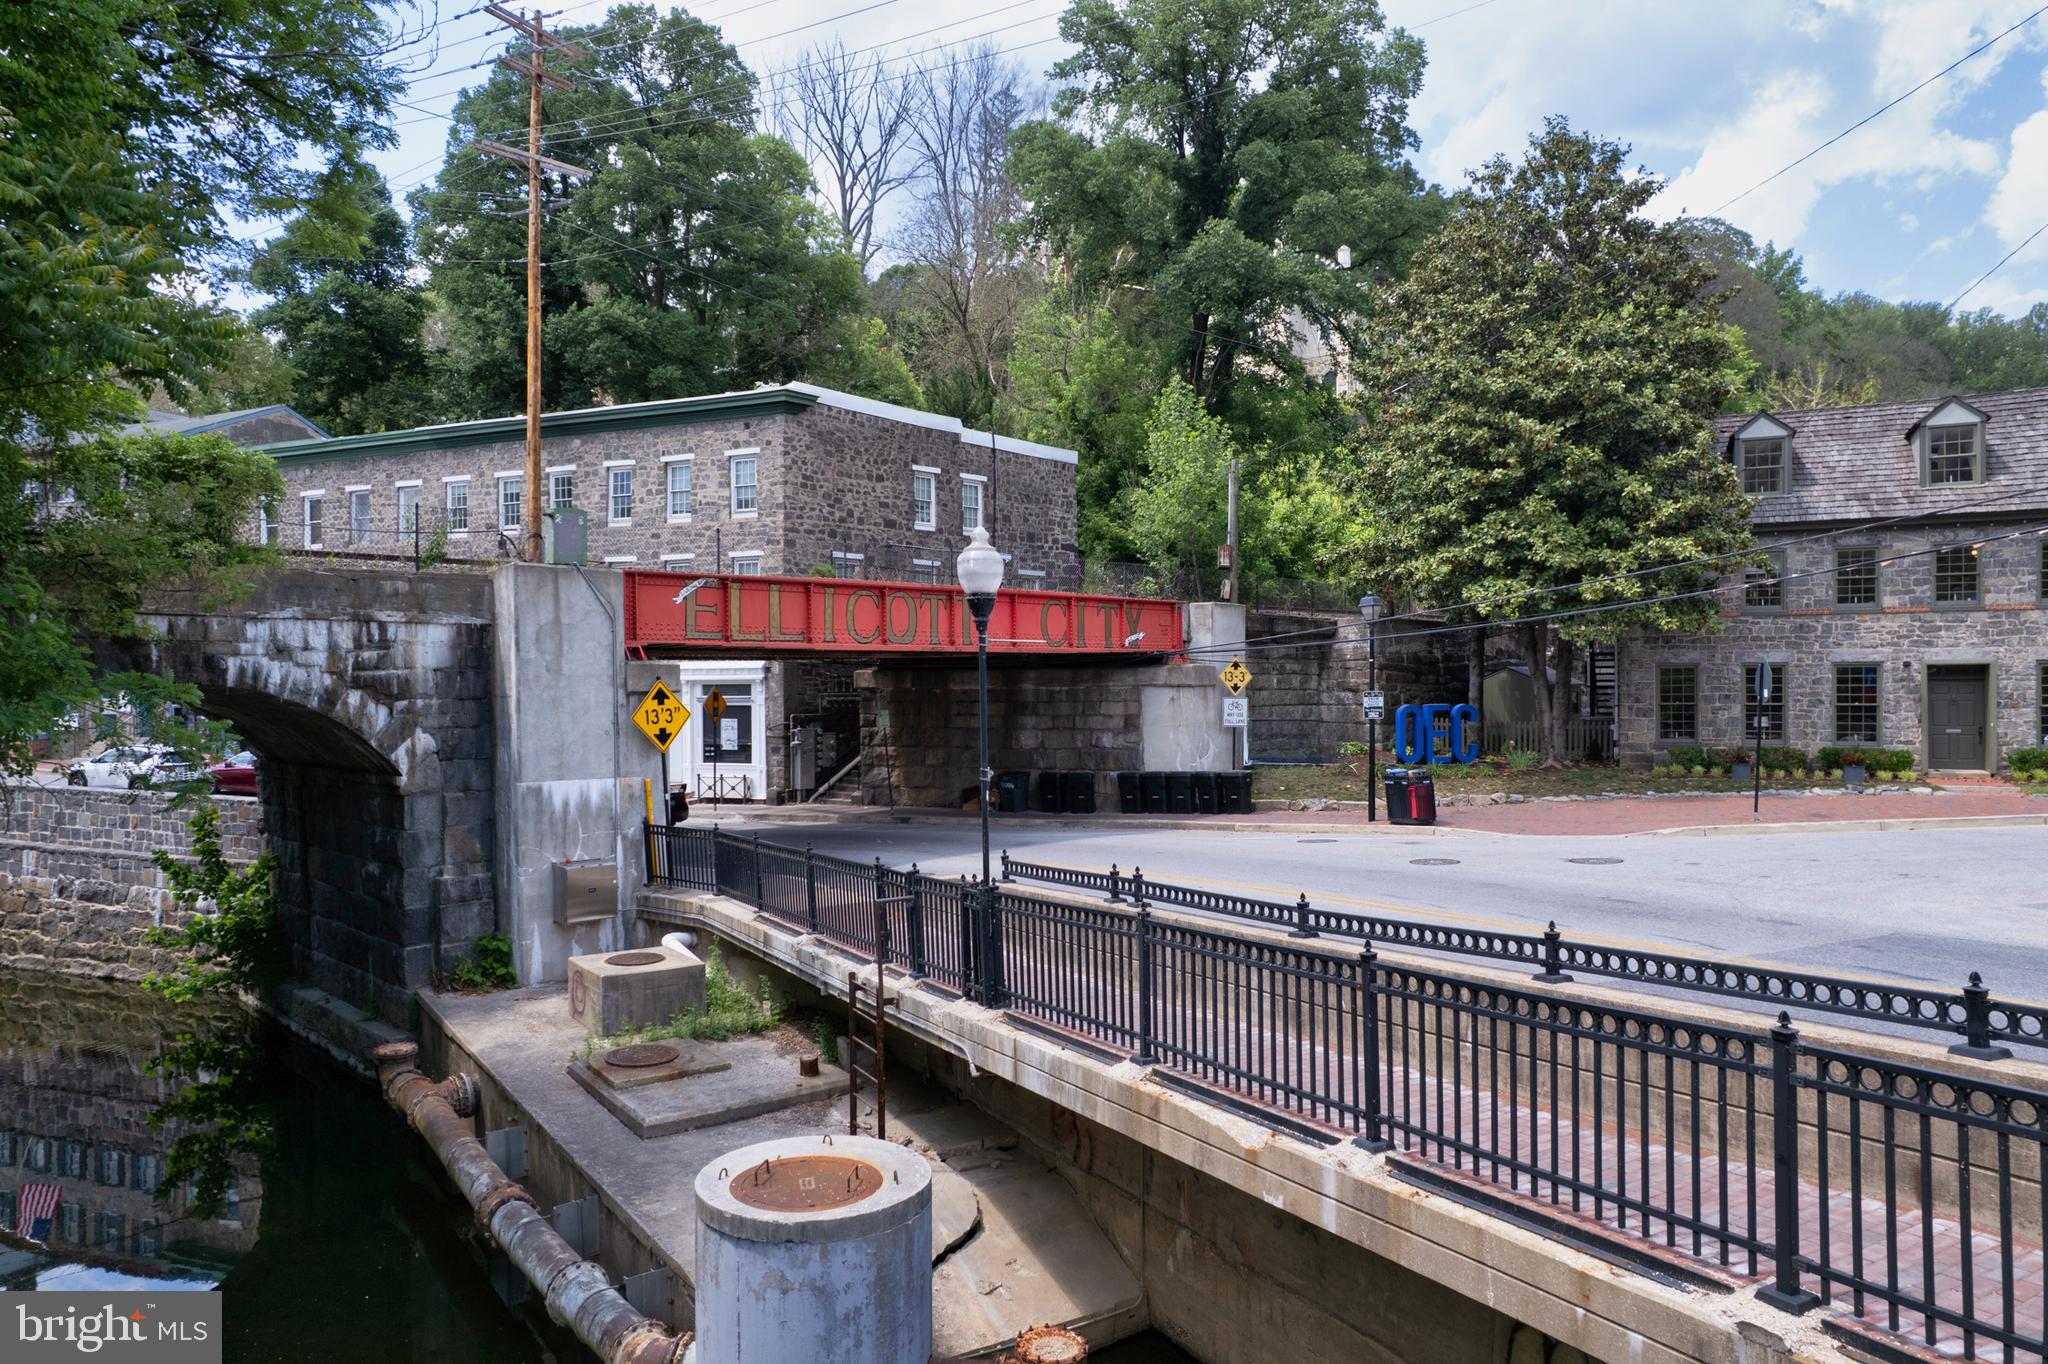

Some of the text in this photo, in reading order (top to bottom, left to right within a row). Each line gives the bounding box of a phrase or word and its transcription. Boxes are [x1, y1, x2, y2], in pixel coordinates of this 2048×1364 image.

[685, 577, 1144, 649] ELLICOTT CITY
[1395, 704, 1480, 764] OEC
